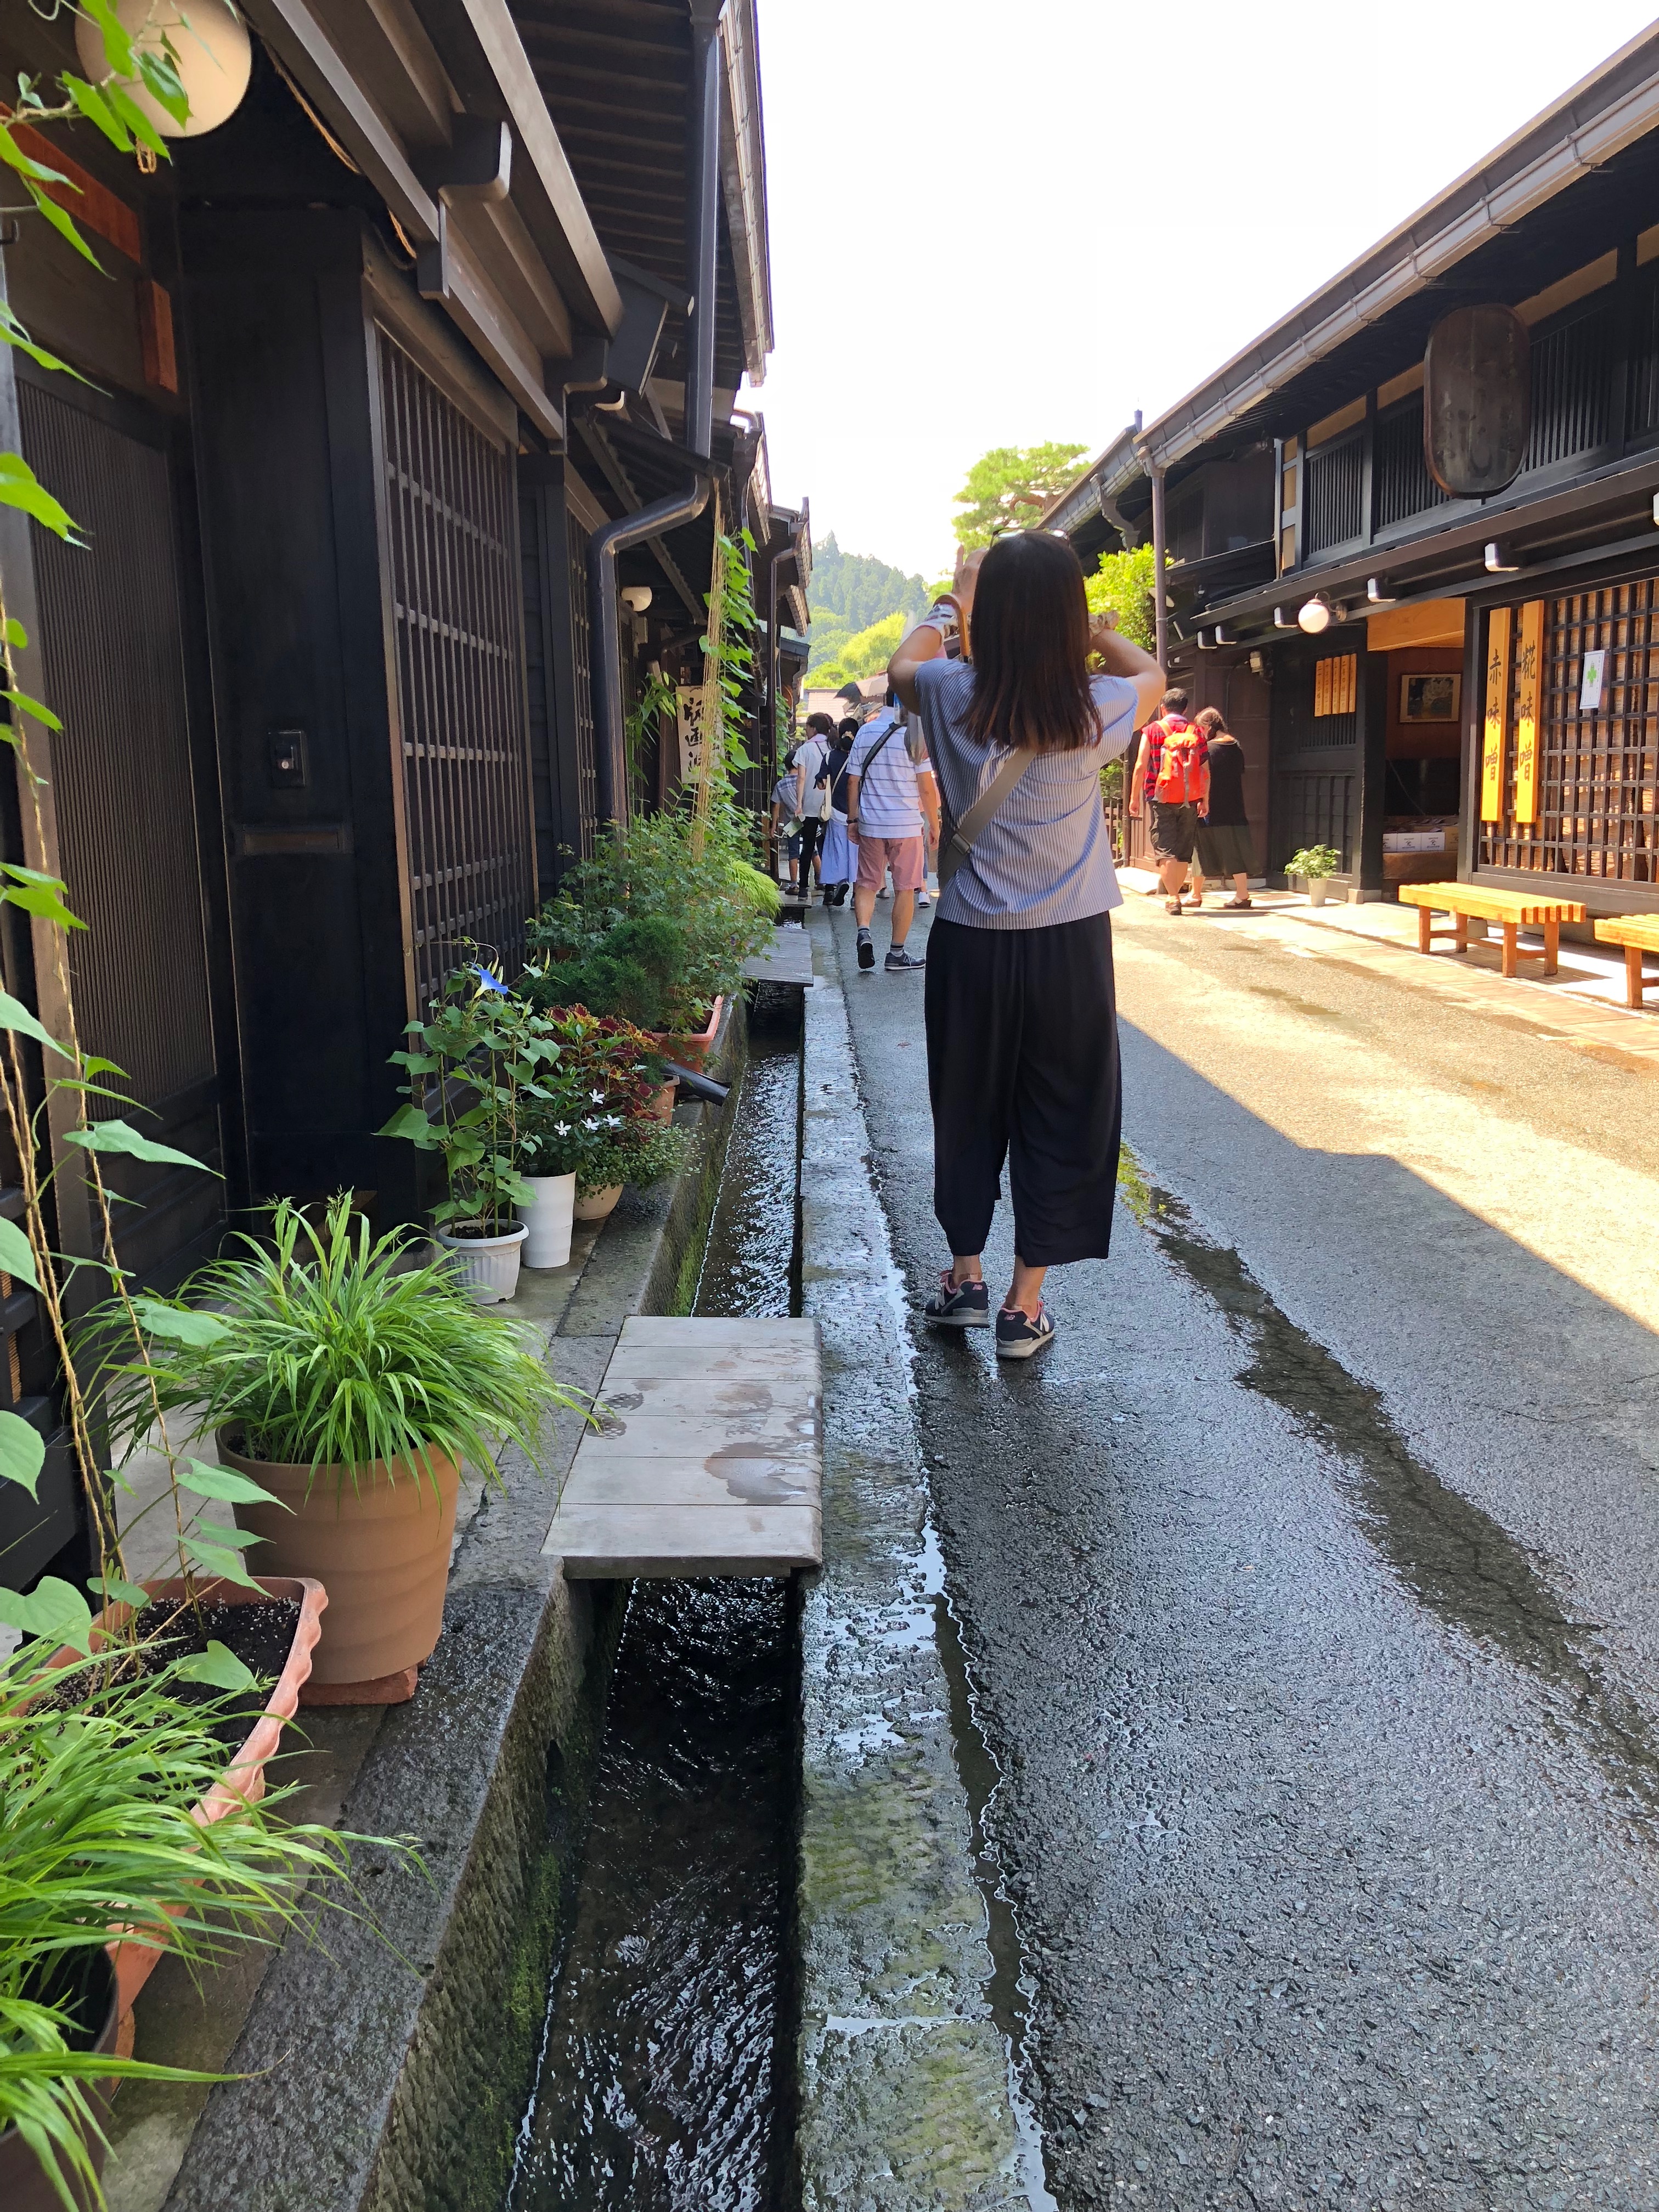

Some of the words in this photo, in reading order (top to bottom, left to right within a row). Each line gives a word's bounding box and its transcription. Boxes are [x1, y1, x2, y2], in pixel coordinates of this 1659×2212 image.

[1485, 648, 1501, 781] 赤味噌
[1519, 640, 1536, 781] 糀味噌
